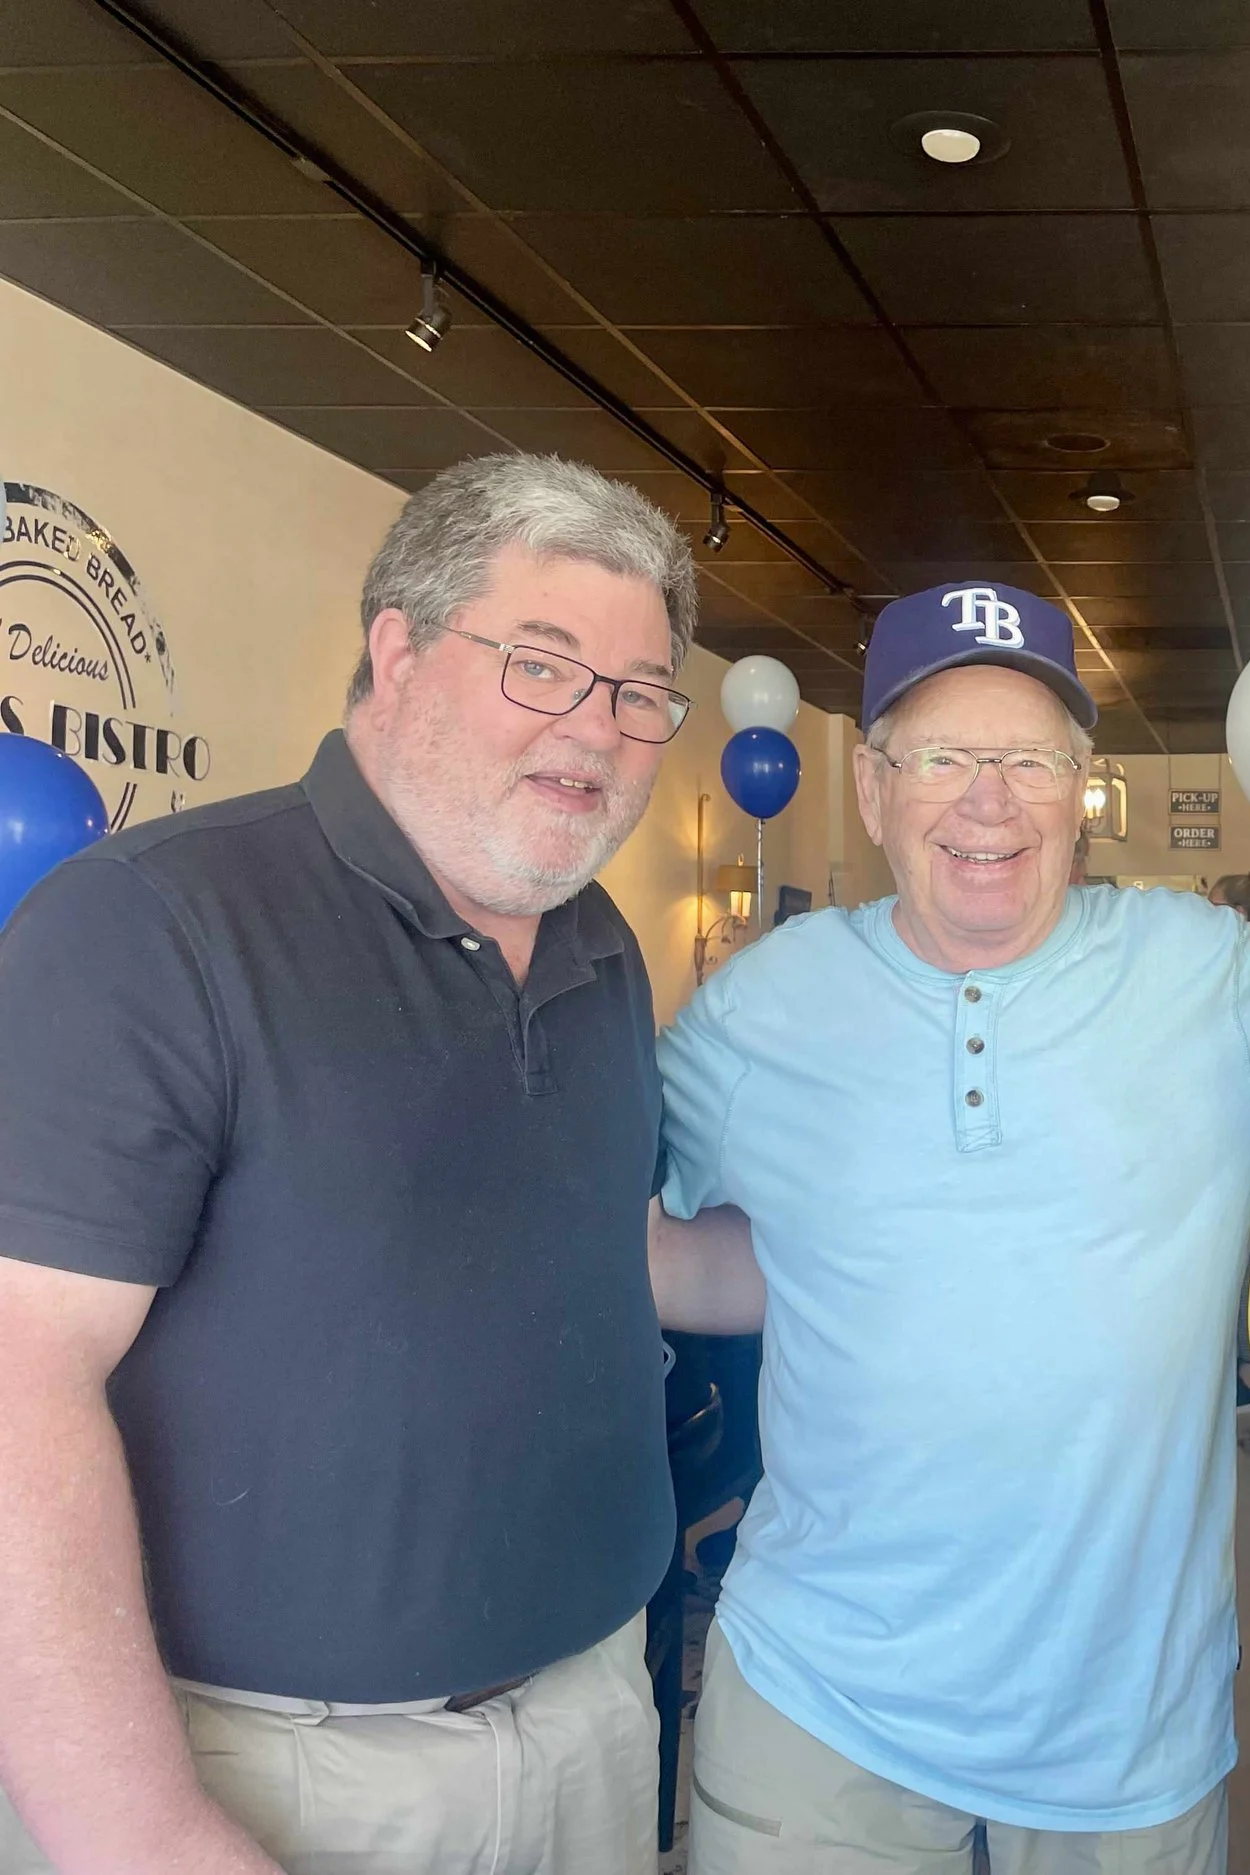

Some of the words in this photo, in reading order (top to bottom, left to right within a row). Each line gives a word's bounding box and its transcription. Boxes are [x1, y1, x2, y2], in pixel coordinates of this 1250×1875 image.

[86, 553, 146, 655] BREAD
[941, 588, 1026, 649] TB
[8, 623, 109, 681] Delicious
[51, 702, 211, 781] BISTRO
[1172, 792, 1218, 803] PICK-UP
[1173, 828, 1215, 839] ORDER
